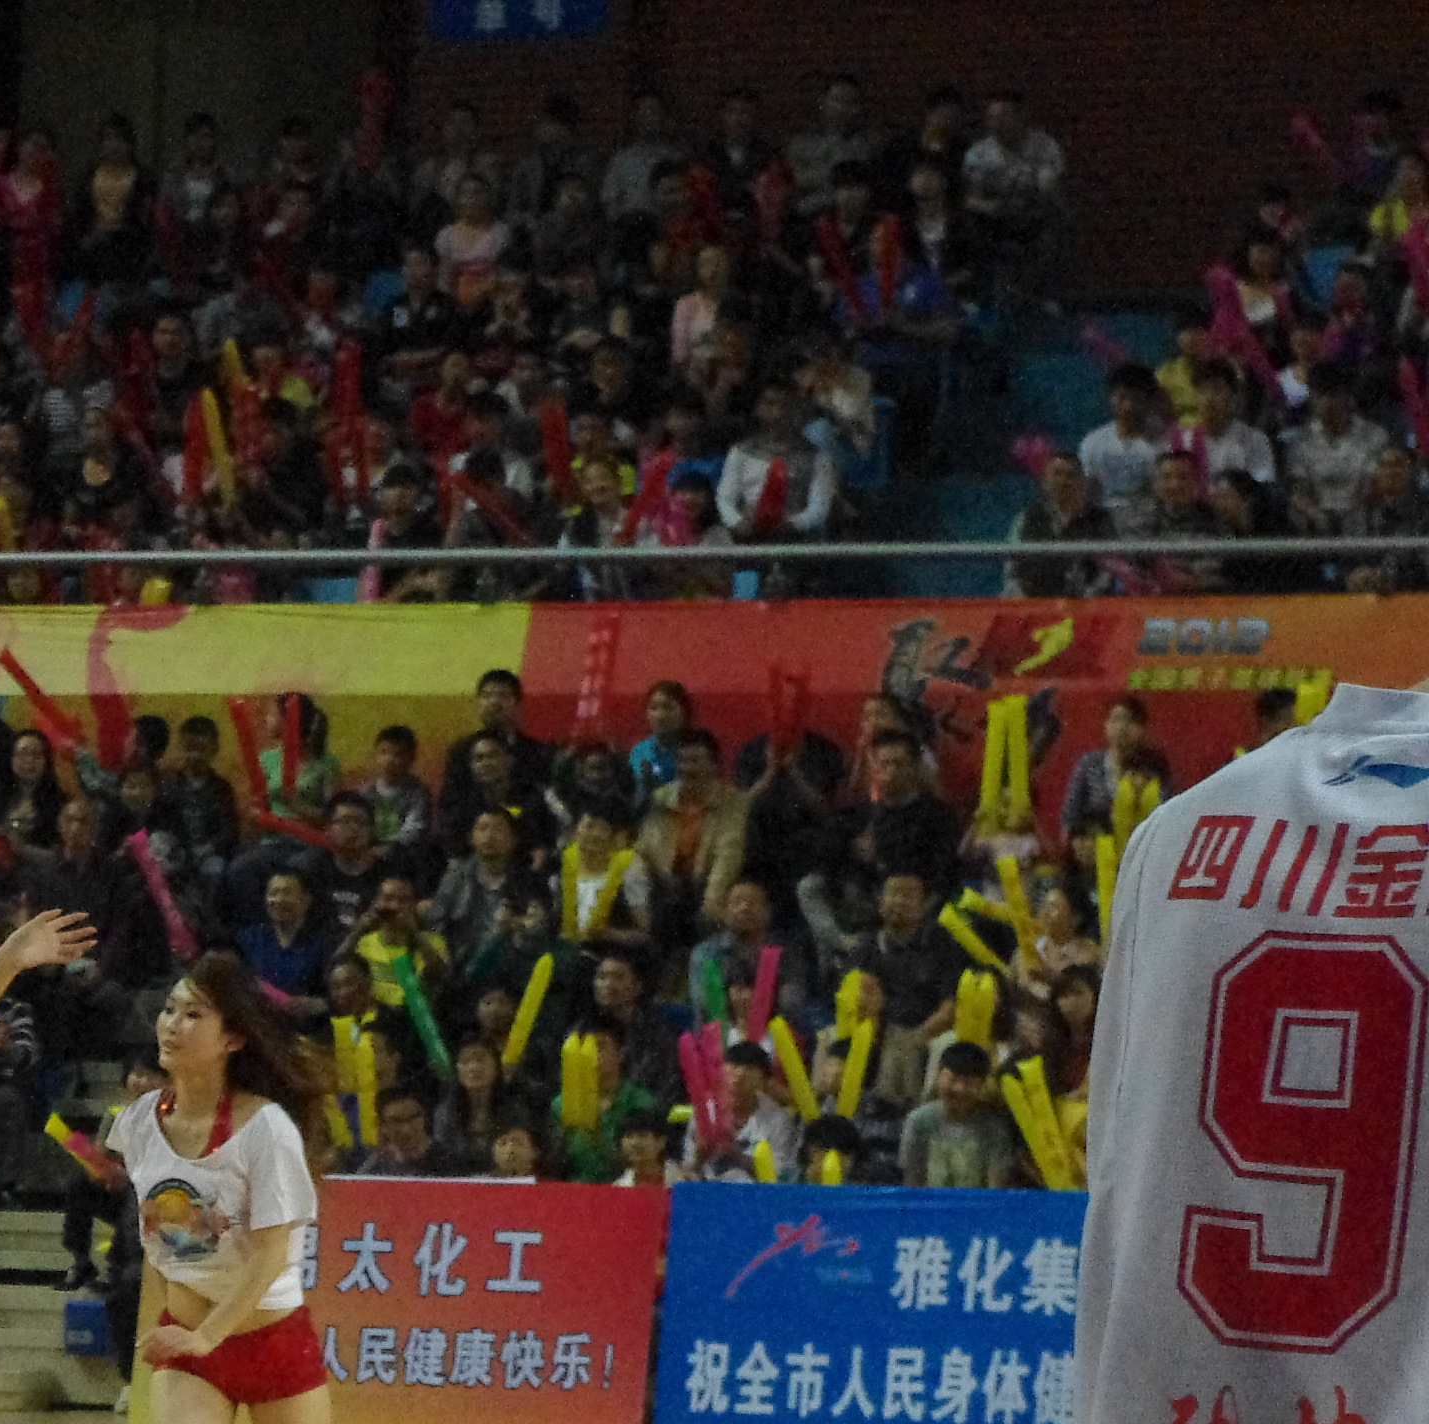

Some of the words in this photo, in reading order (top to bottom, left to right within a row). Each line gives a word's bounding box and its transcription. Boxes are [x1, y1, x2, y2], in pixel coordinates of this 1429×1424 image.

[1167, 814, 1429, 919] 四川金
[1178, 929, 1429, 1356] 9
